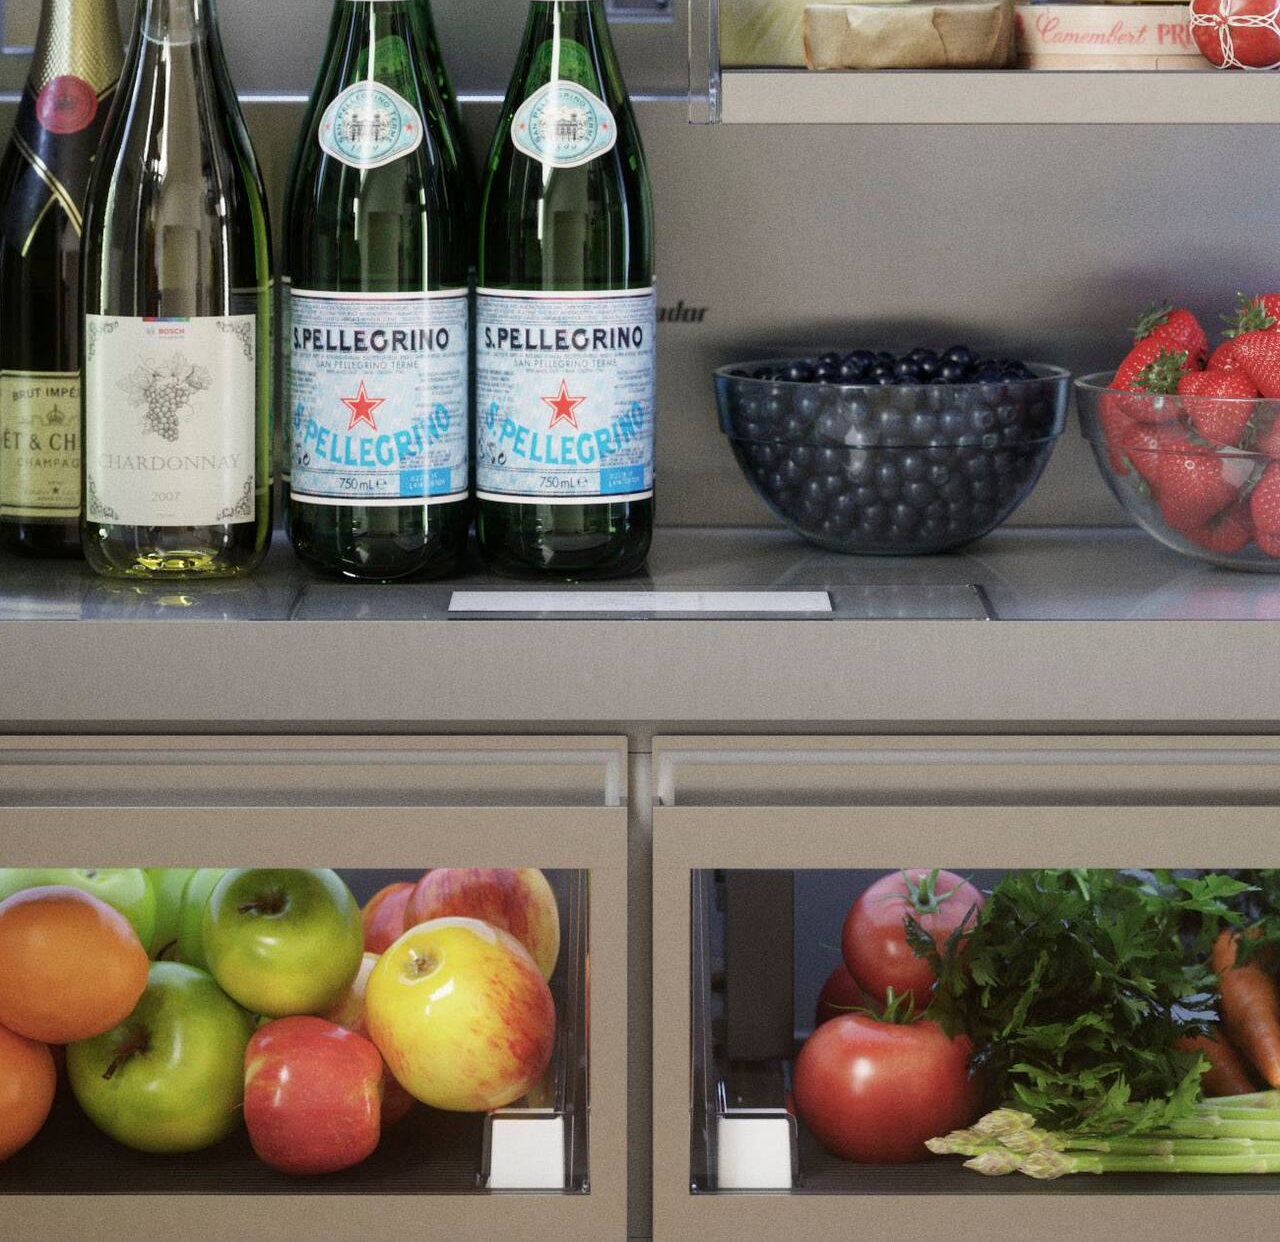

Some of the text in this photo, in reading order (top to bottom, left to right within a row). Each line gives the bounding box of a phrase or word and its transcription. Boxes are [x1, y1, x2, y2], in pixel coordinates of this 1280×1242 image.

[1036, 11, 1147, 46] Camembert
[338, 93, 391, 120] PELLEGINO
[533, 92, 587, 119] PELLRINO
[294, 326, 450, 353] S.PELLEGRINO
[485, 325, 643, 351] S.PELLEGRINO
[317, 361, 419, 370] SAN PELLEGRINO TERME
[514, 358, 618, 368] SAN PELLEGRINO TERME
[12, 387, 41, 401] BRUT
[29, 433, 42, 452] &
[99, 453, 242, 472] CHARDONNAY
[151, 491, 181, 502] 2007
